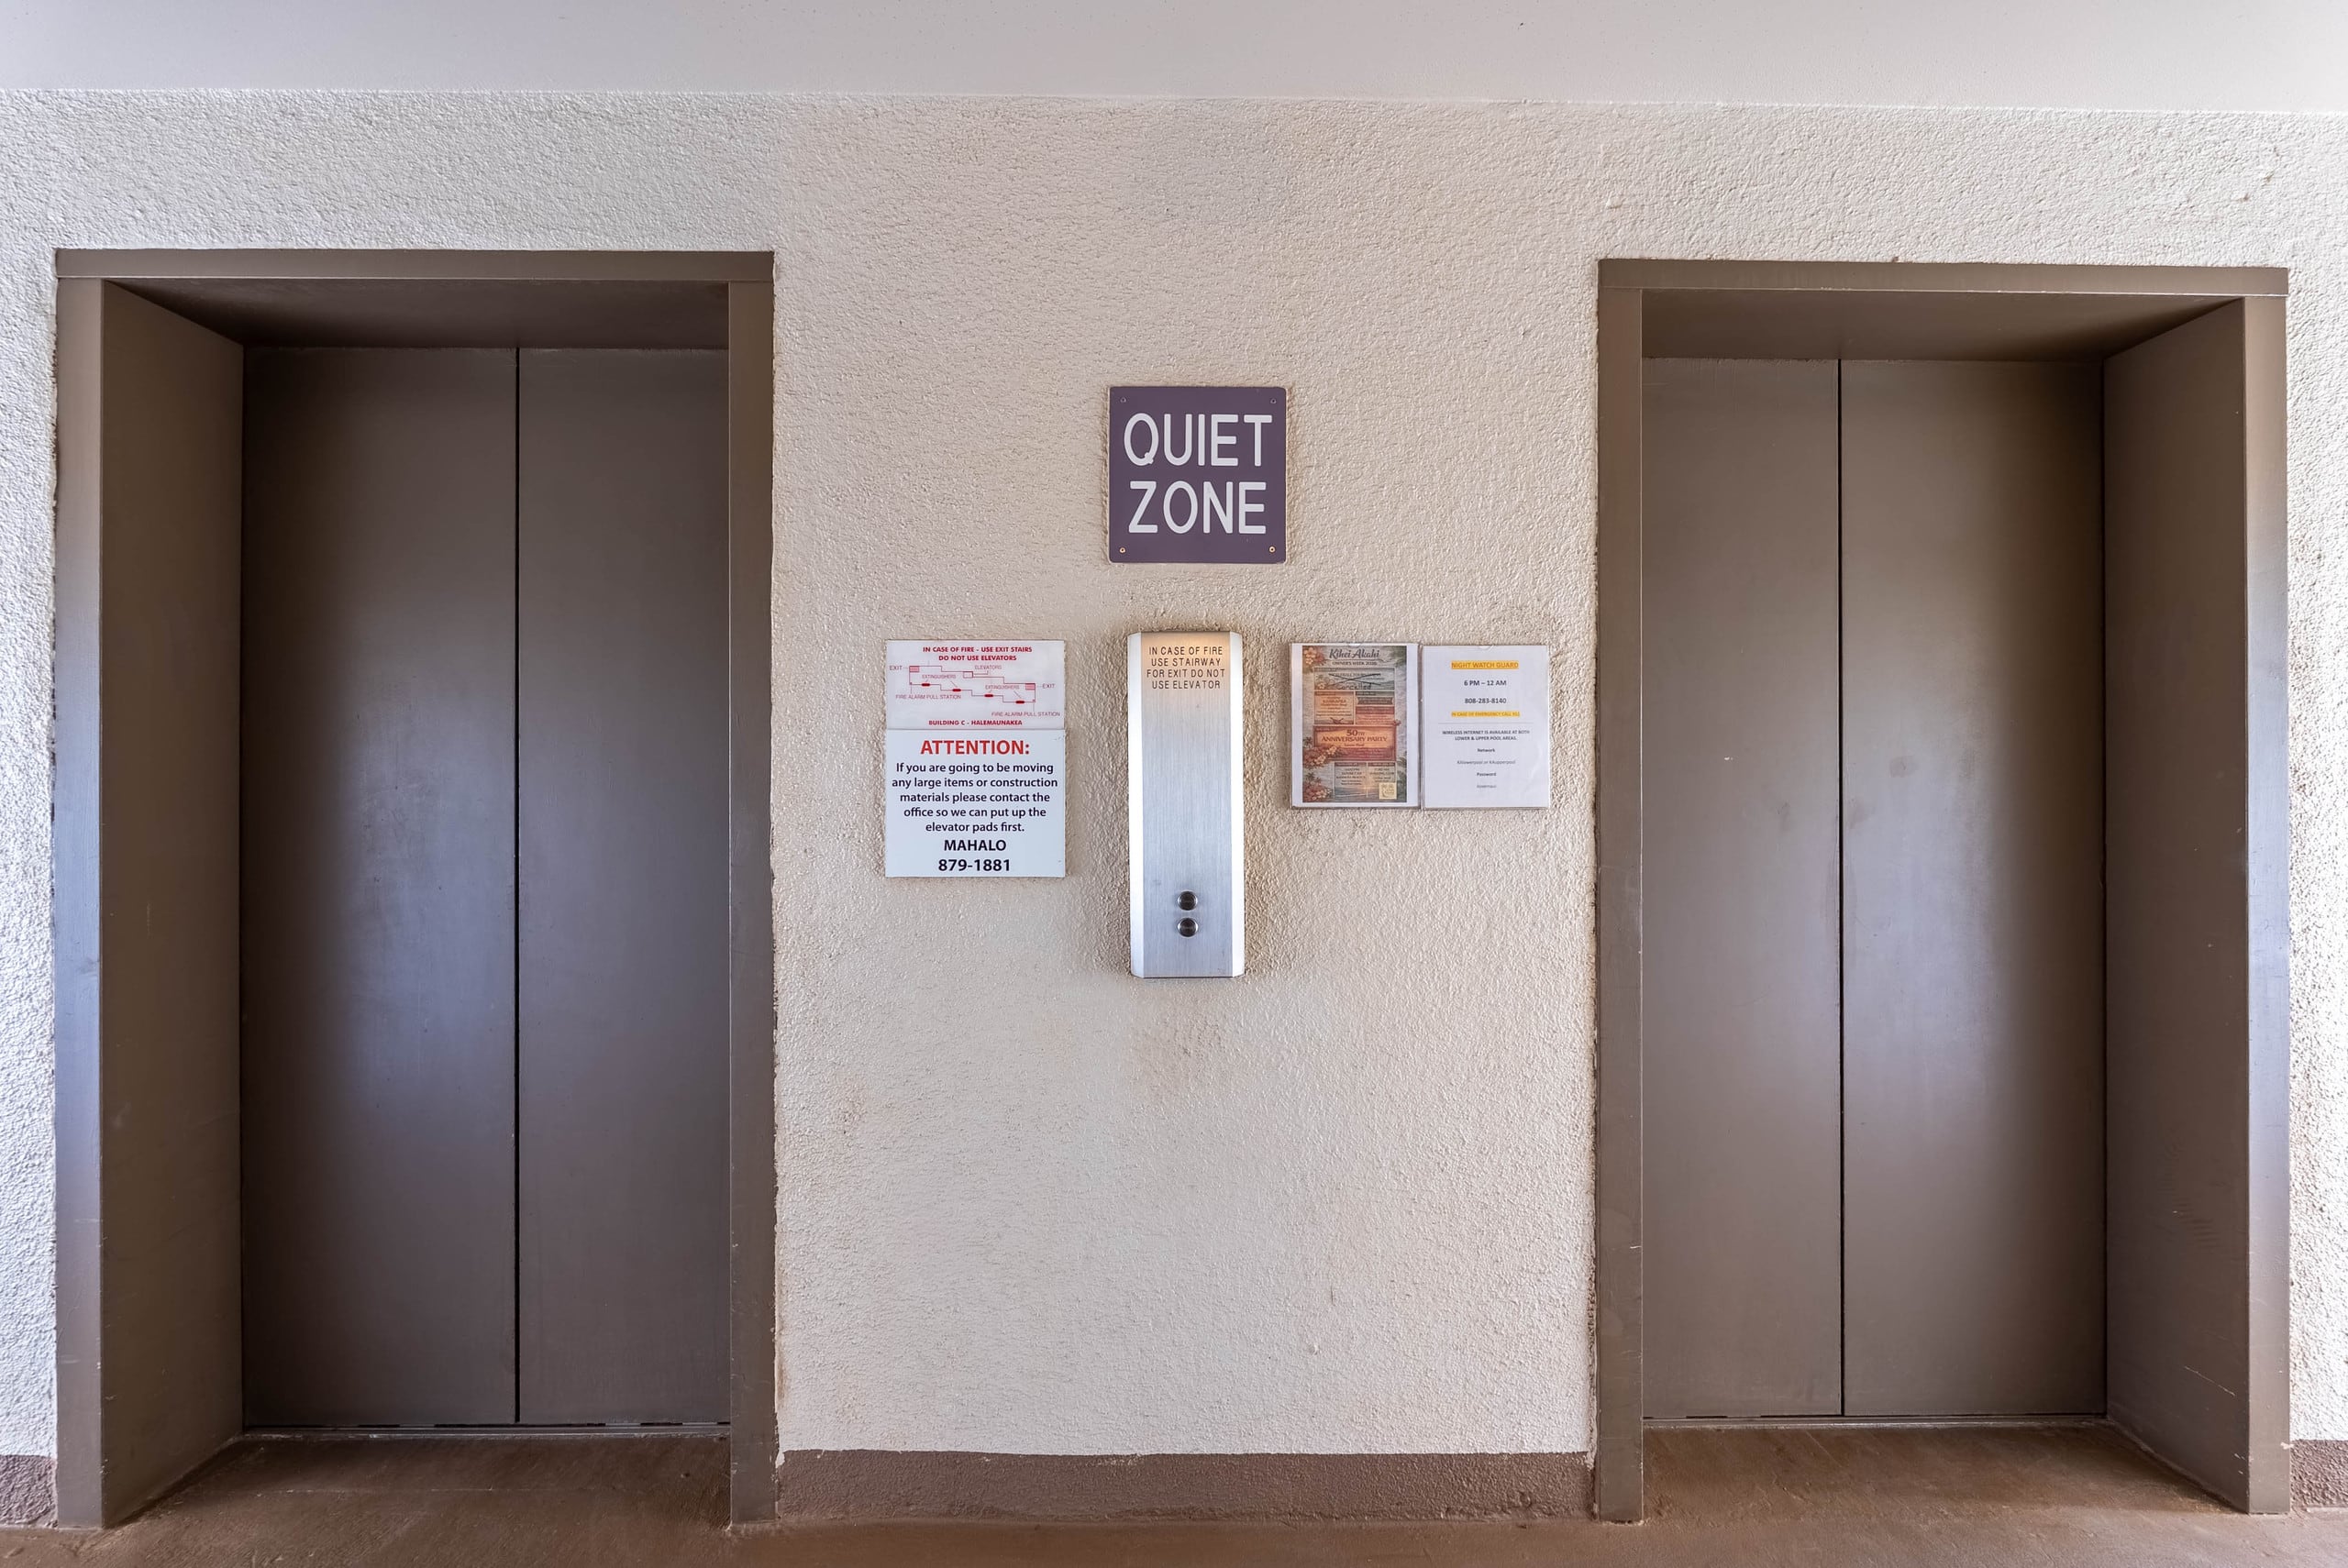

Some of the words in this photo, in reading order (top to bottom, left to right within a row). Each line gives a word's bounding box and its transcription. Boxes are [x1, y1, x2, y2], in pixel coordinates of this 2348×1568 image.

[1124, 413, 1272, 466] QUIET
[1129, 481, 1266, 534] ZONE
[1149, 646, 1157, 655] IN
[1160, 646, 1185, 655] CASE
[1189, 646, 1200, 655] OF
[1204, 646, 1223, 655] FIRE
[1329, 649, 1351, 659] Kihei
[1352, 649, 1380, 658] Akahi
[1151, 658, 1169, 667] USE
[1172, 658, 1221, 667] STAIRWAY
[1147, 669, 1164, 678] FOR
[1167, 669, 1188, 678] EXIT
[1191, 669, 1204, 678] DO
[1207, 669, 1225, 678] NOT
[1152, 680, 1169, 689] USE
[1173, 680, 1220, 689] ELEVATOR
[920, 740, 1030, 755] ATTENTION:
[896, 763, 905, 772] If
[906, 765, 926, 774] you
[949, 763, 979, 774] going
[983, 764, 994, 772] to
[997, 763, 1010, 772] be
[1013, 763, 1053, 774] moving
[892, 780, 911, 789] any
[915, 777, 941, 789] large
[944, 778, 973, 787] items
[990, 778, 1058, 787] construction
[900, 792, 949, 802] materials
[952, 792, 987, 804] please
[1032, 792, 1050, 802] the
[904, 807, 933, 816] office
[990, 808, 1009, 818] put
[1012, 809, 1026, 818] up
[1029, 807, 1046, 816] the
[926, 822, 970, 831] elevator
[972, 822, 998, 834] pads
[1001, 822, 1025, 831] first.
[944, 840, 1006, 851] MAHALO
[938, 859, 1009, 871] 879-1881
